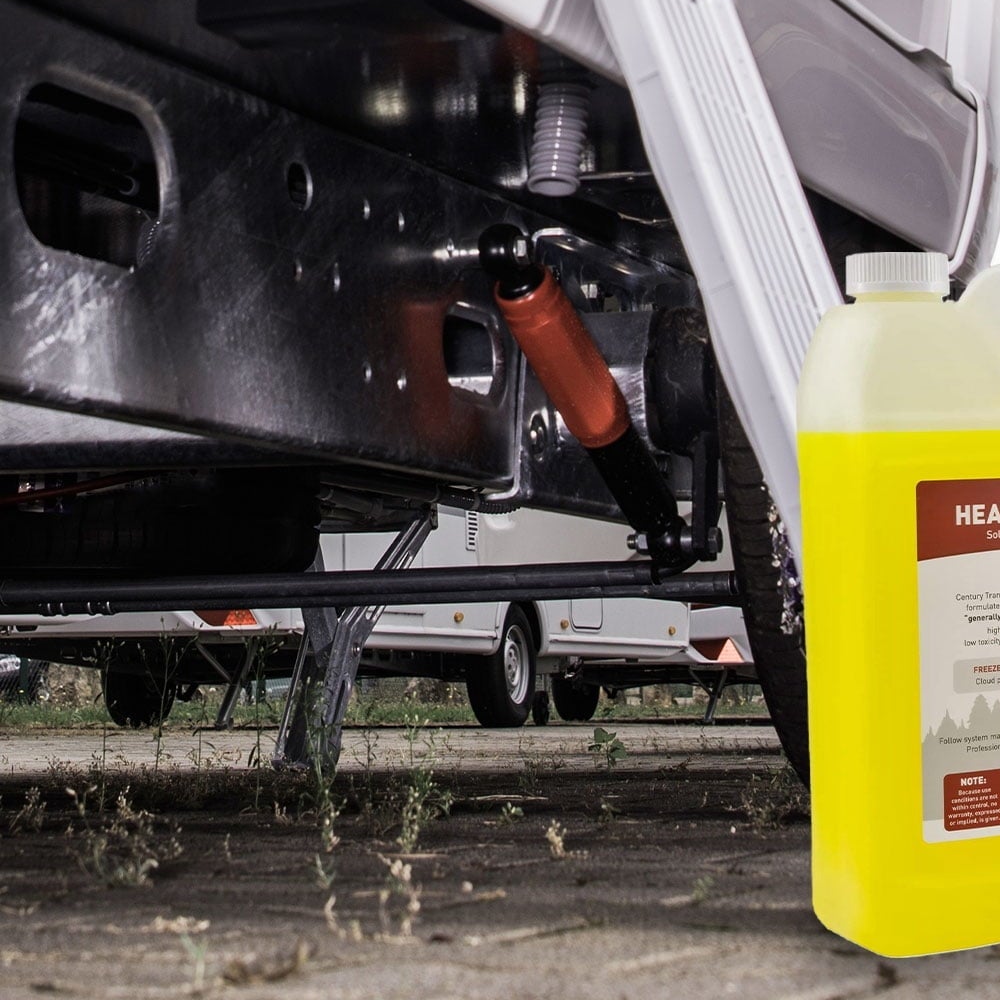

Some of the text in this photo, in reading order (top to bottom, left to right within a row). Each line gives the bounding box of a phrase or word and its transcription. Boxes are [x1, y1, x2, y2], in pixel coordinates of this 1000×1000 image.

[956, 593, 984, 602] Century
[976, 677, 995, 685] Cloud
[940, 737, 962, 745] Follow
[964, 734, 988, 744] system
[960, 776, 986, 786] NOTE:
